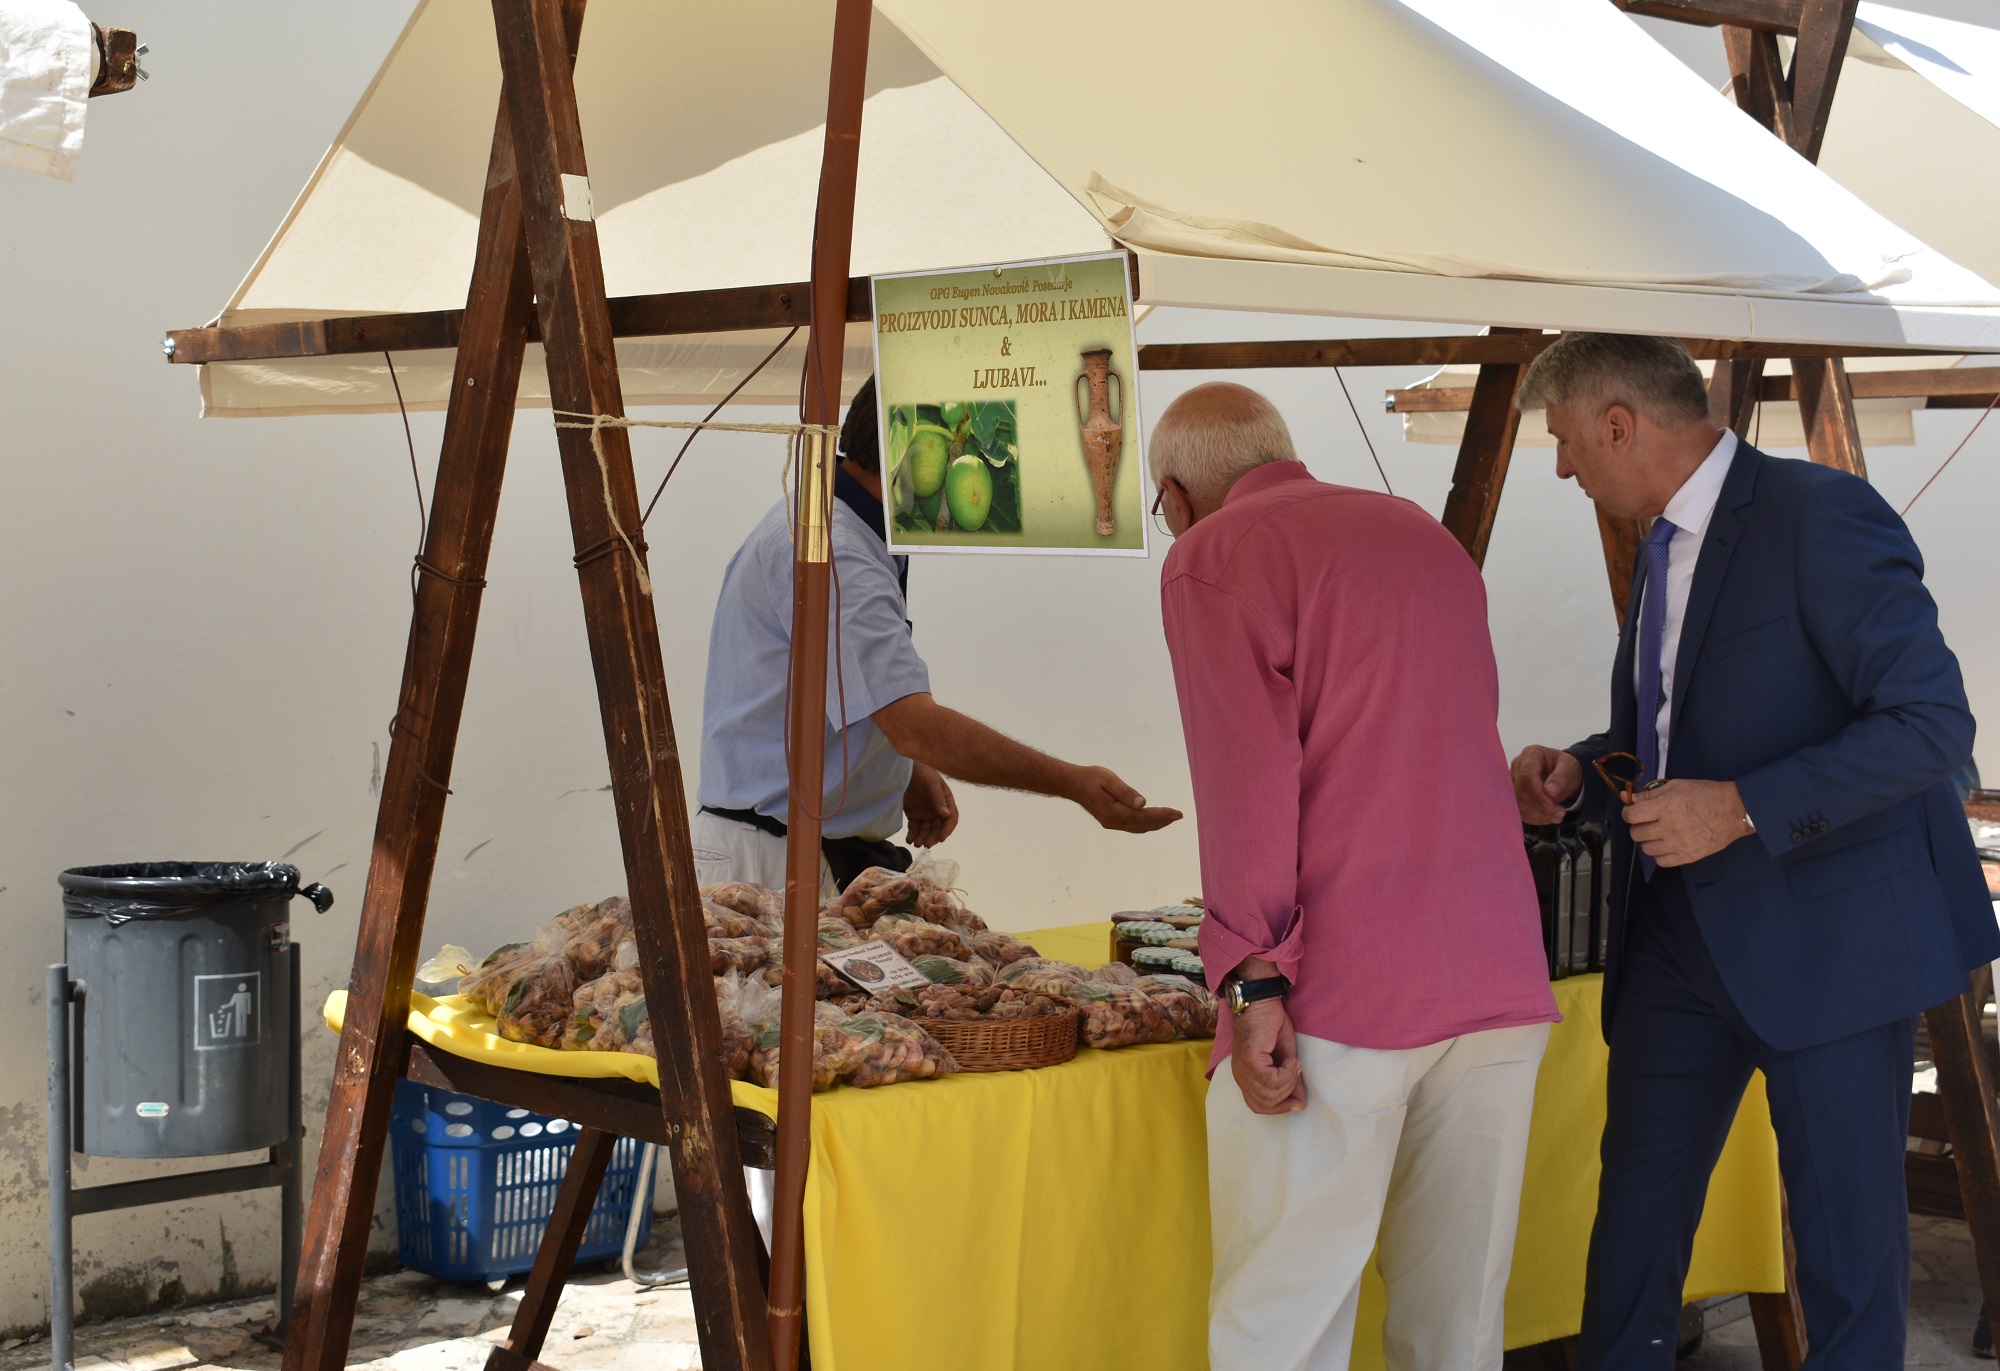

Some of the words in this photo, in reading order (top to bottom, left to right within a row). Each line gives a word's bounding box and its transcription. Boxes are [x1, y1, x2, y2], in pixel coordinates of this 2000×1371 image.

[930, 287, 951, 300] OPG
[952, 286, 981, 301] Eugen
[982, 280, 1030, 296] Novaković
[878, 308, 958, 333] PROIZVODI
[959, 305, 1012, 329] SUNCA,
[1015, 301, 1058, 324] MORA
[1060, 300, 1067, 321] I
[1068, 295, 1127, 320] KAMENA
[1000, 336, 1012, 357] &
[973, 366, 1047, 389] LJUBAVI...
